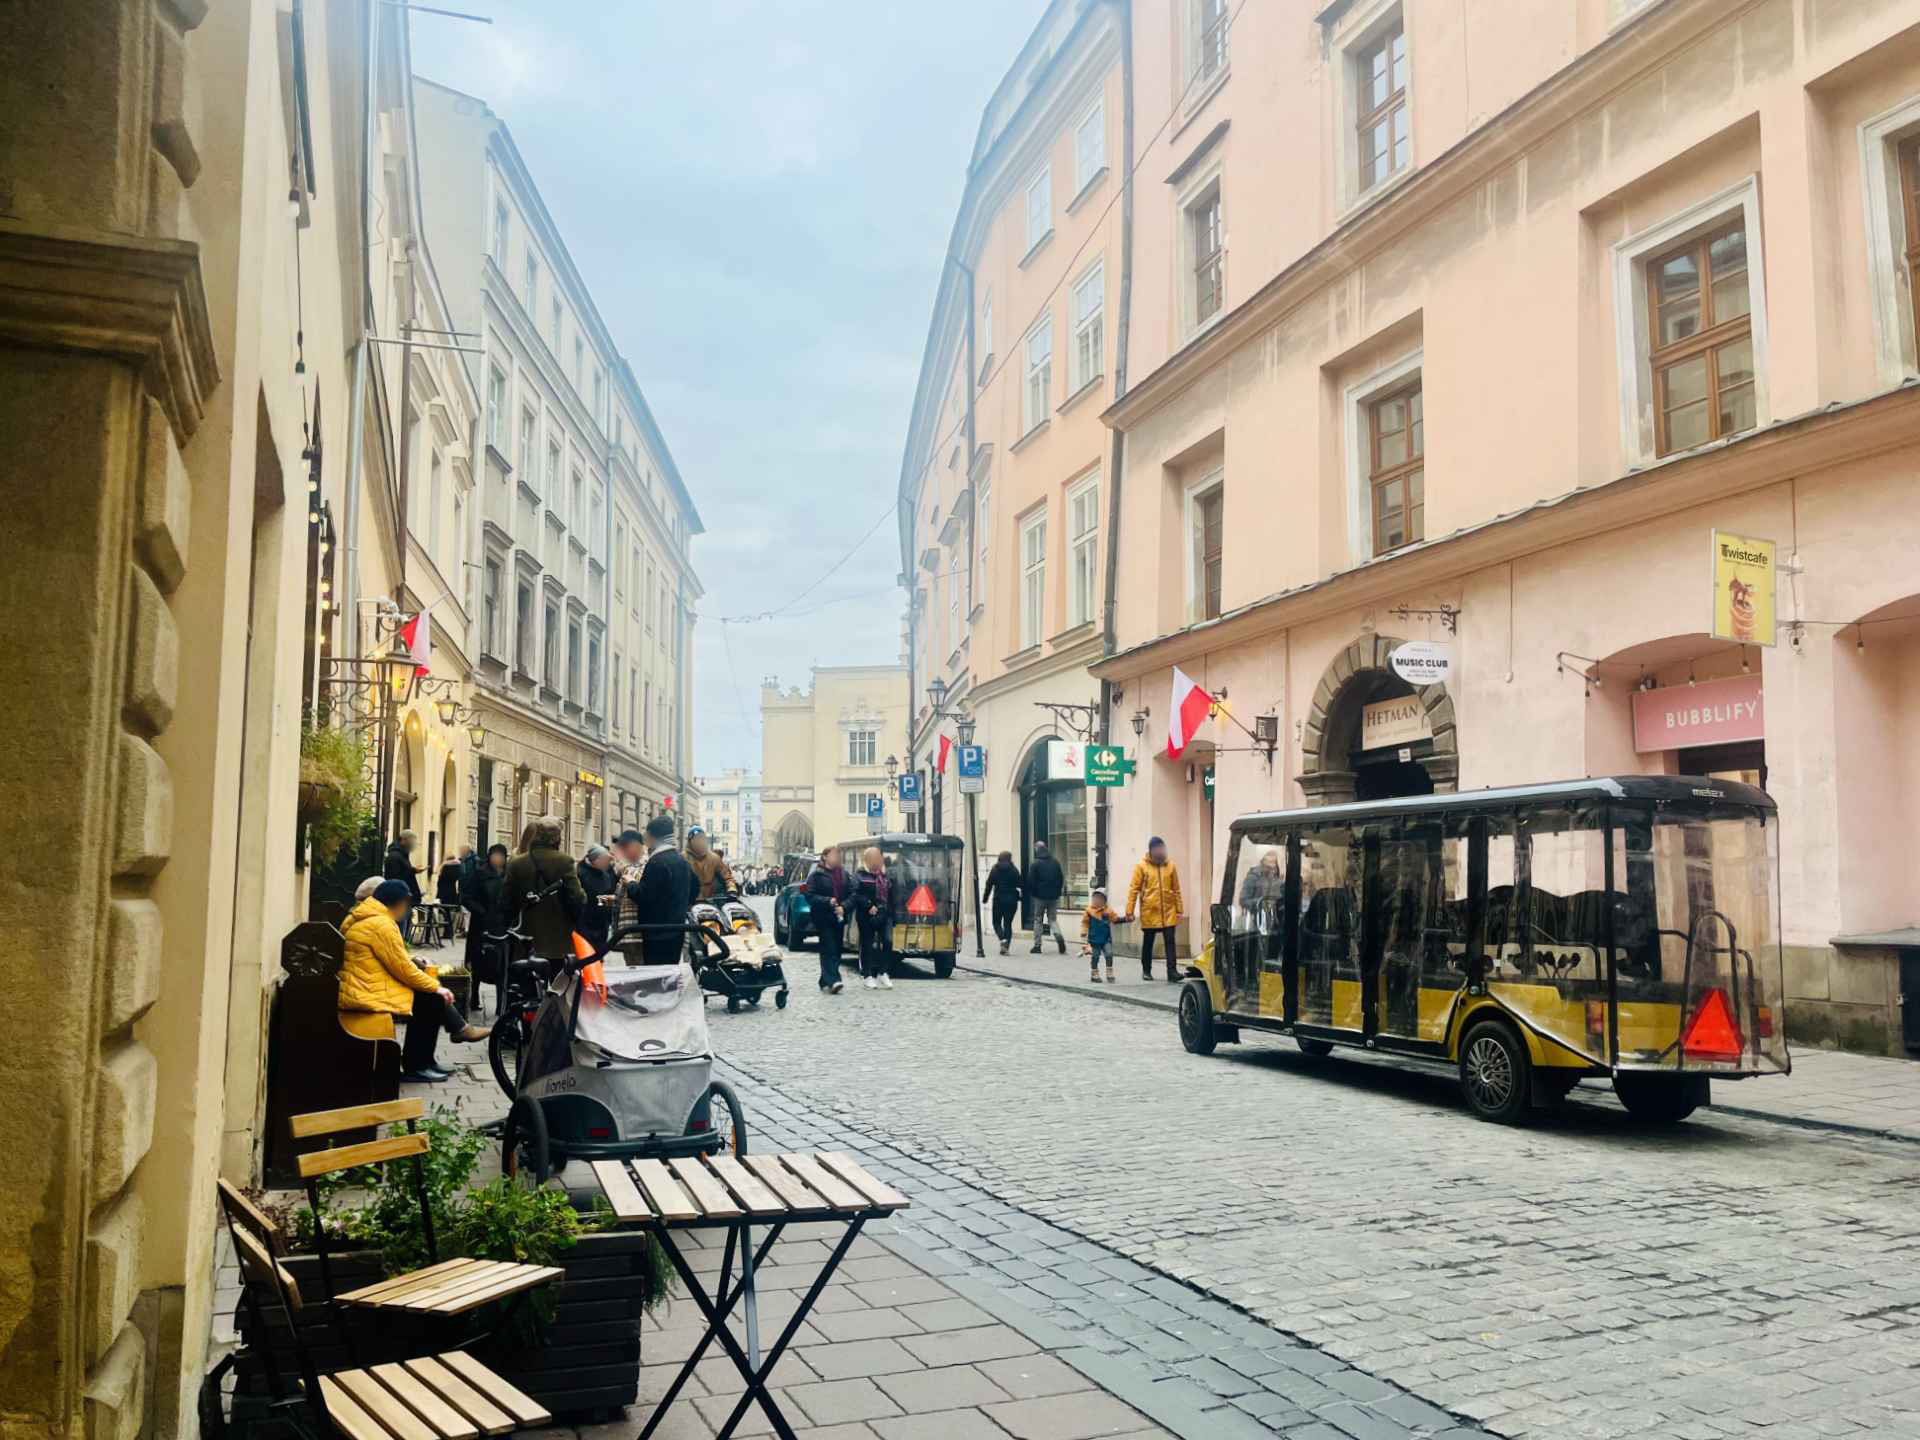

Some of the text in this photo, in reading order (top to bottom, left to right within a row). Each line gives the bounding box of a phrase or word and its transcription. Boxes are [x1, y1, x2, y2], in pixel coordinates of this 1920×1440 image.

[1720, 543, 1768, 565] Twistcafe
[1395, 658, 1448, 668] MUSIC CLUB
[1366, 703, 1418, 728] HETMAN
[1665, 700, 1757, 729] BUBBLIFY
[963, 748, 977, 767] P
[903, 777, 914, 793] P
